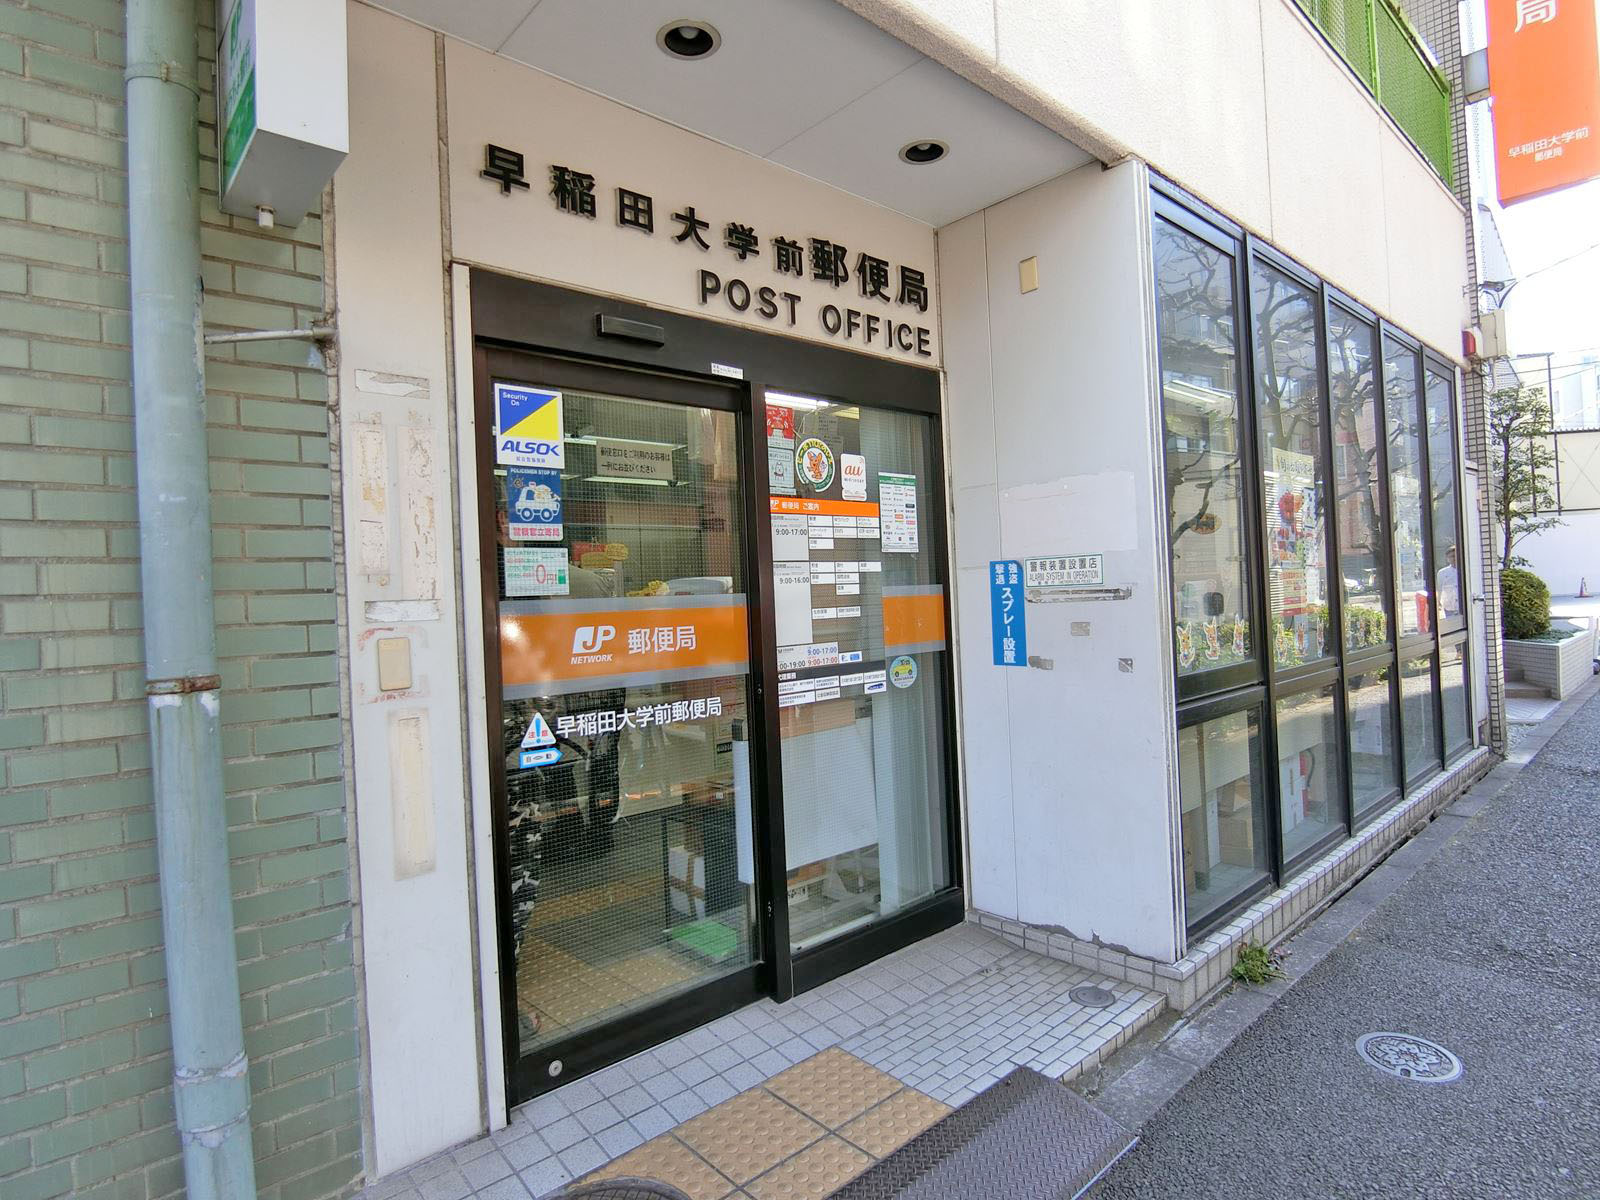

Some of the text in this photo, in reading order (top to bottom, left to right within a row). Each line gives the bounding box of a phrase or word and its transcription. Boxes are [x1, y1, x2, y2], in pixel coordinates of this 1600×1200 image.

[1508, 126, 1590, 159] 早稲田大学前
[1535, 146, 1564, 163] 郵便局
[481, 142, 929, 314] 早稲田大学前郵便局
[697, 269, 933, 358] POST OFFICE
[502, 391, 528, 401] Security
[510, 399, 520, 407] On
[501, 439, 561, 457] ALSOK
[844, 465, 864, 477] au
[775, 527, 808, 536] 9:00-17:00
[1007, 562, 1018, 584] 強盗
[1030, 557, 1098, 573] 警報装置設置店
[779, 576, 810, 584] 9:00-16:00
[994, 562, 1005, 585] 撃退
[1029, 569, 1099, 582] ALARM SYSTEM IN OPERATION
[1000, 587, 1017, 664] スプレー設置
[627, 625, 697, 655] 郵便局
[570, 653, 613, 665] NETWORK
[807, 646, 837, 656] 9:00-17:00
[807, 656, 838, 667] 9:00-17:00
[556, 696, 722, 739] 早稲田大学前郵便局
